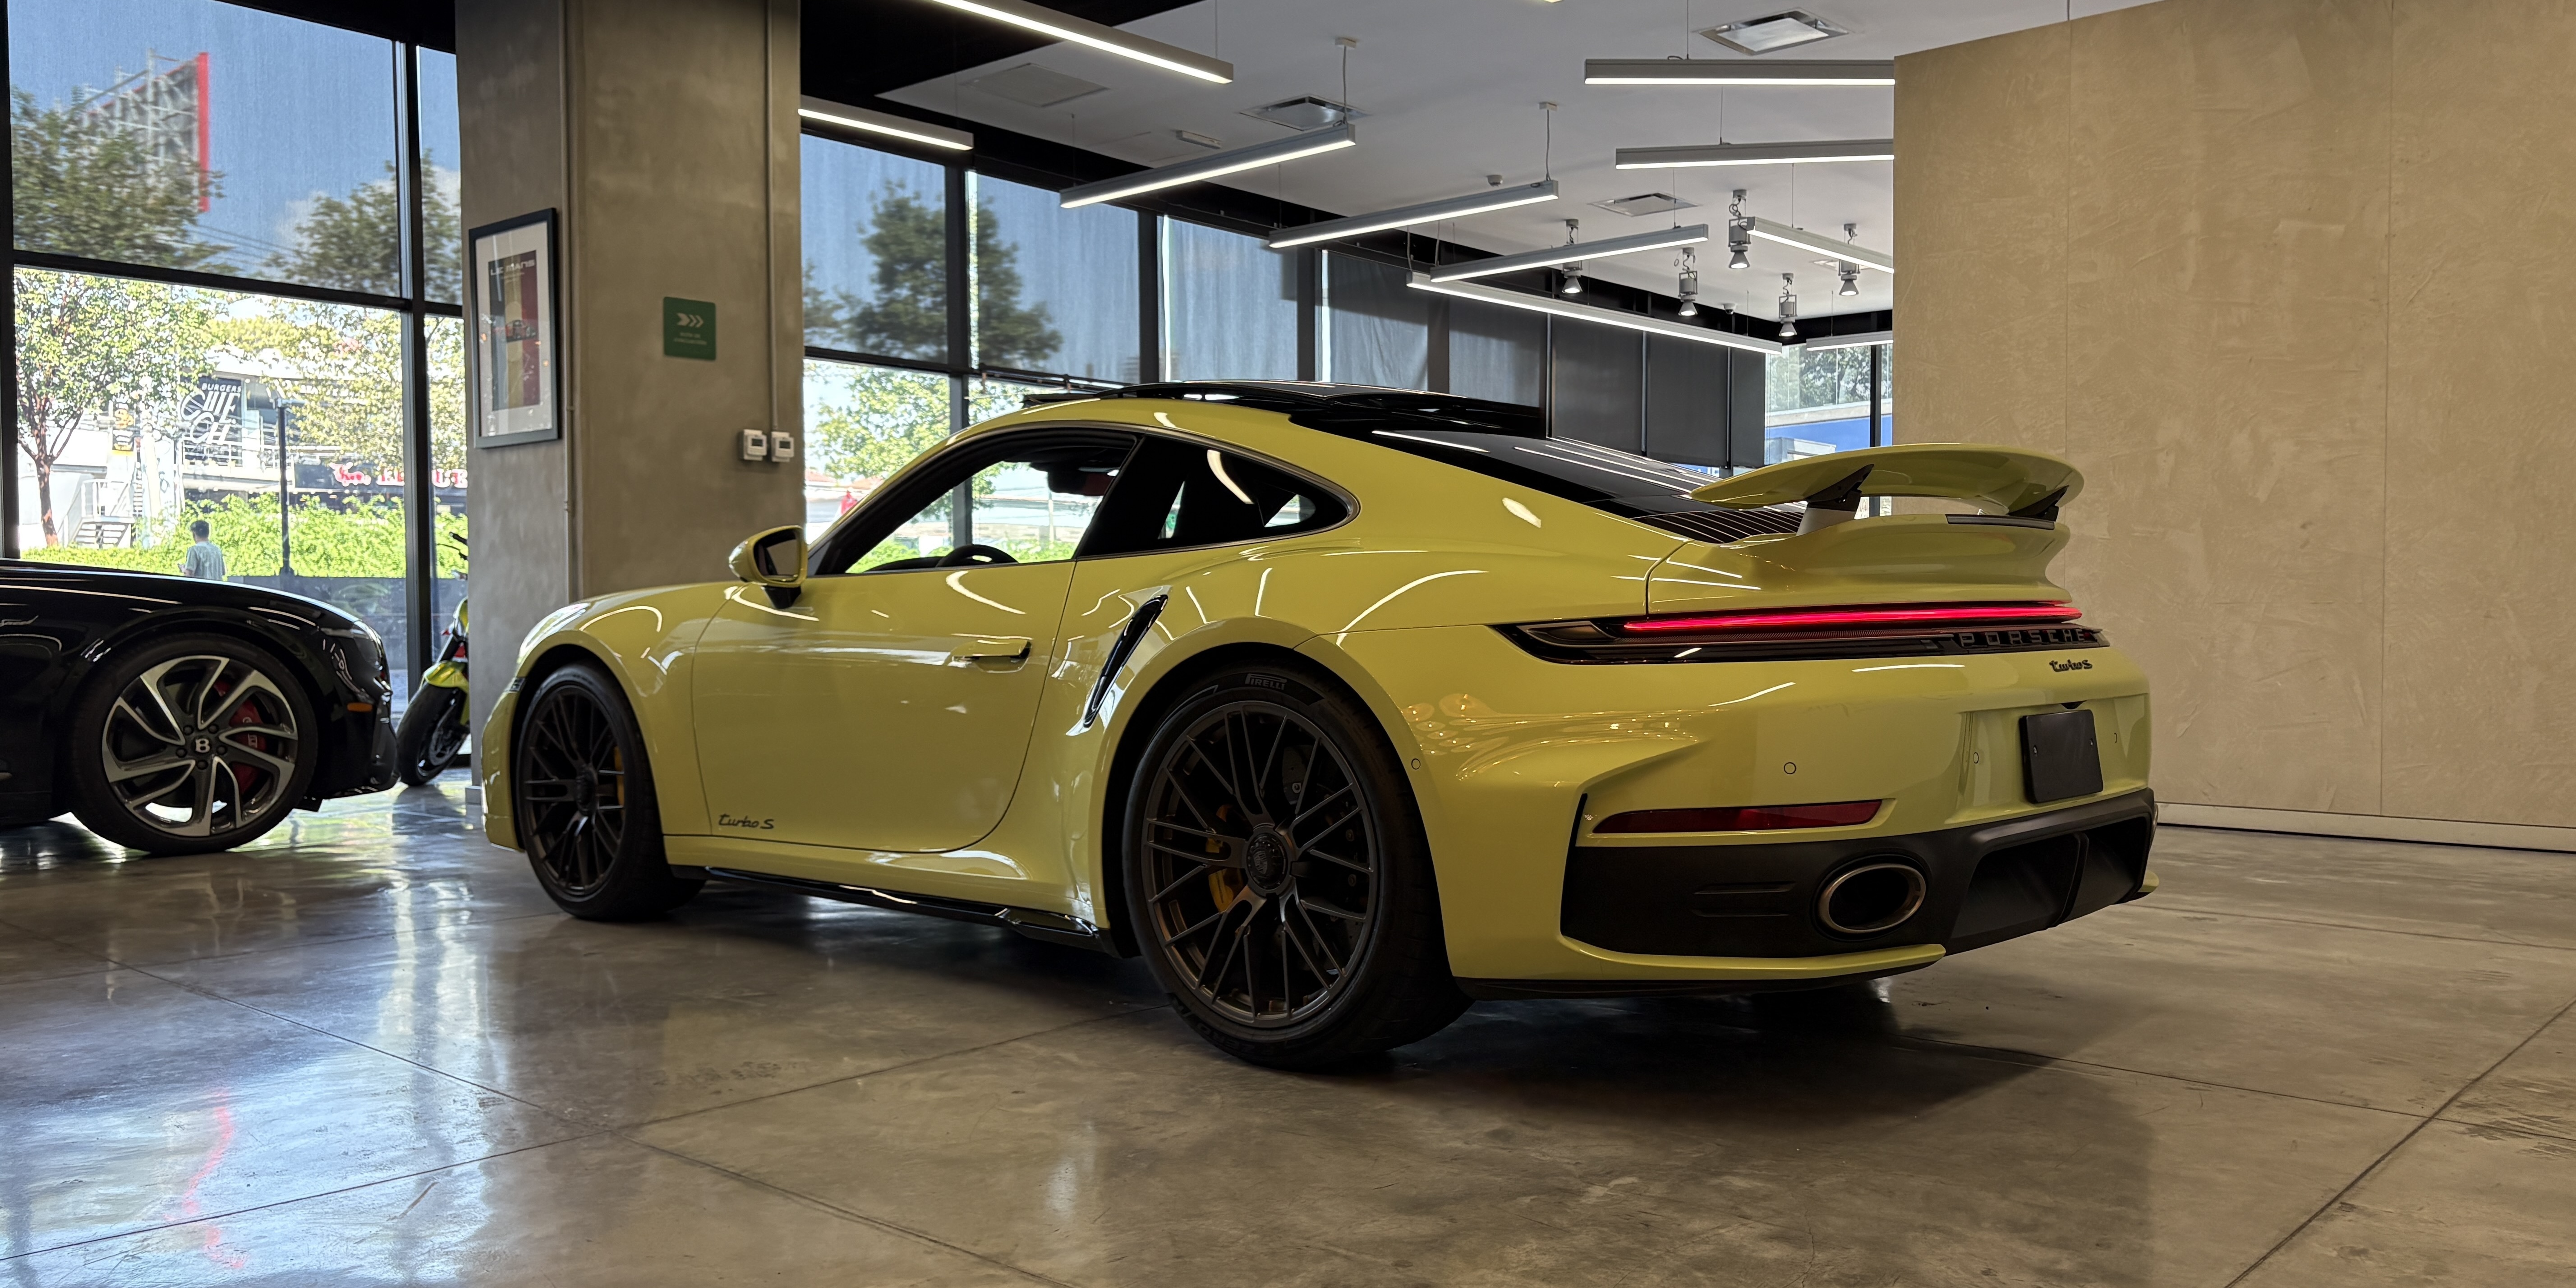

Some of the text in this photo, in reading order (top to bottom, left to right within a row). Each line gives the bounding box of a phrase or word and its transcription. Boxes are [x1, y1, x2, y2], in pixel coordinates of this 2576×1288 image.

[202, 383, 241, 393] BURGERS
[1959, 629, 2084, 647] PORSCHE
[1245, 673, 1287, 690] PIRELLI
[195, 738, 210, 753] B
[760, 819, 774, 829] S
